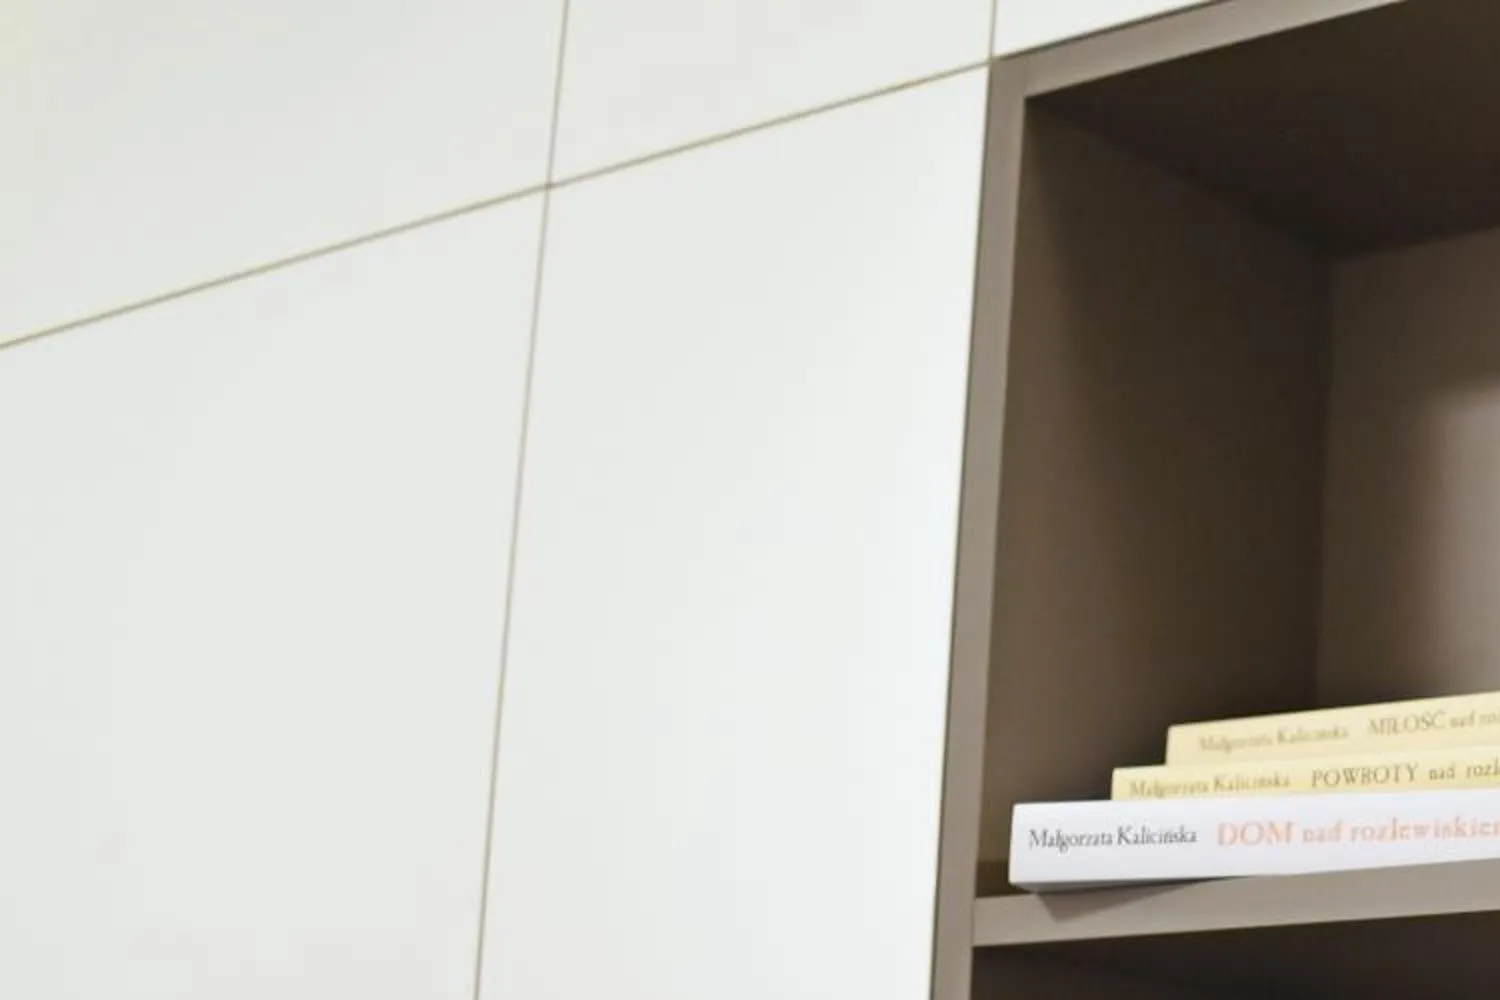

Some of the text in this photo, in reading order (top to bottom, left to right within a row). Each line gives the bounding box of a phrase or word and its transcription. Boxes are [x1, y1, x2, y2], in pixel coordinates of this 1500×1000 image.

[1311, 762, 1418, 788] POWROTY
[1428, 766, 1456, 782] nad
[1028, 827, 1113, 852] Małgorzata
[1116, 825, 1198, 847] Kalicińska
[1216, 820, 1296, 846] DOM
[1302, 819, 1342, 843] nad
